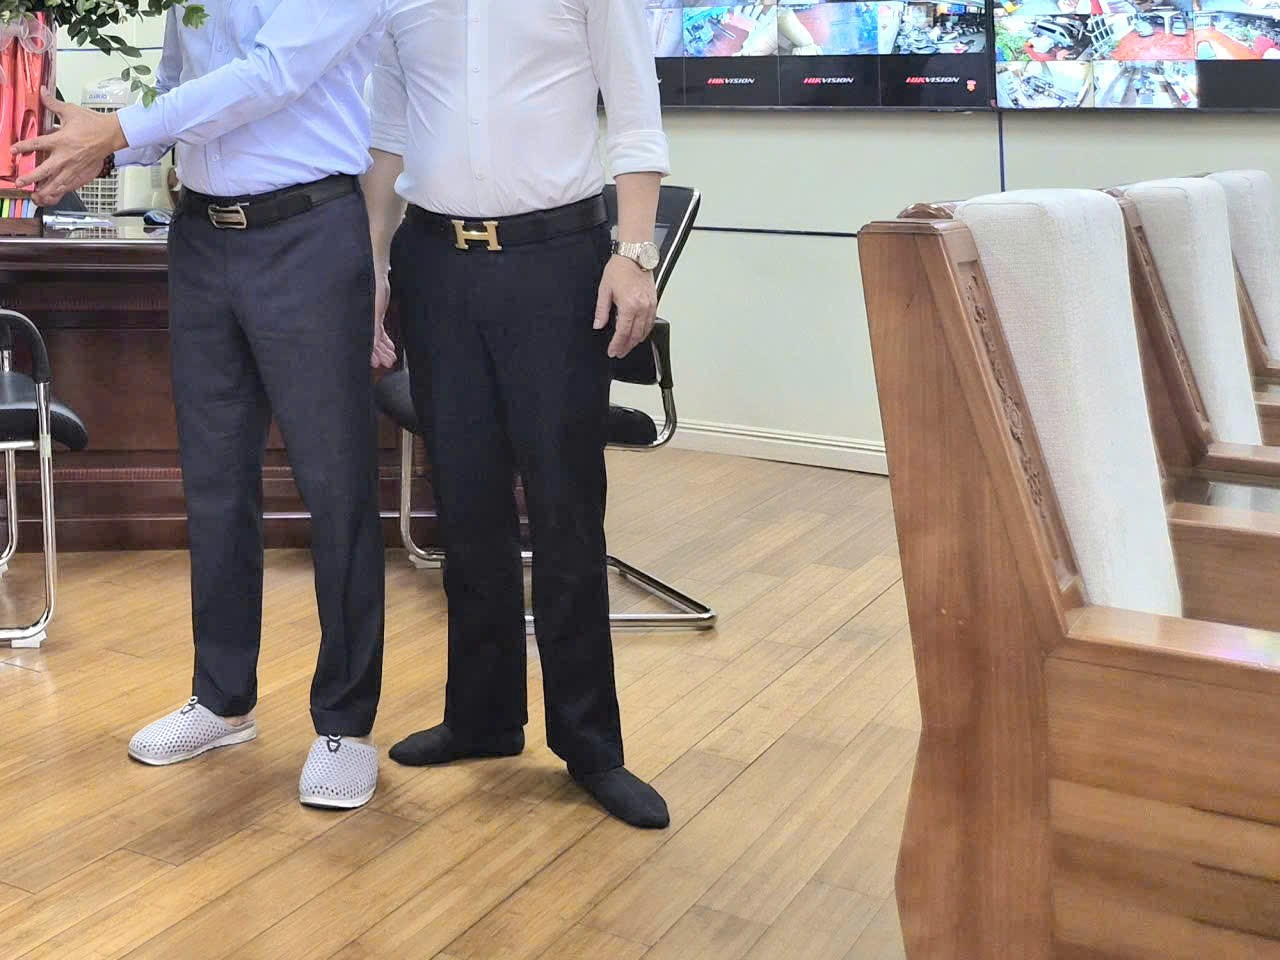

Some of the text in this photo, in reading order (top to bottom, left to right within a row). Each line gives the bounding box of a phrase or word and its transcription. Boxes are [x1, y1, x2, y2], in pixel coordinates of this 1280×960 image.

[706, 77, 756, 86] HIKVISION
[803, 76, 855, 85] HIKVISION
[905, 76, 960, 84] HIKVISION
